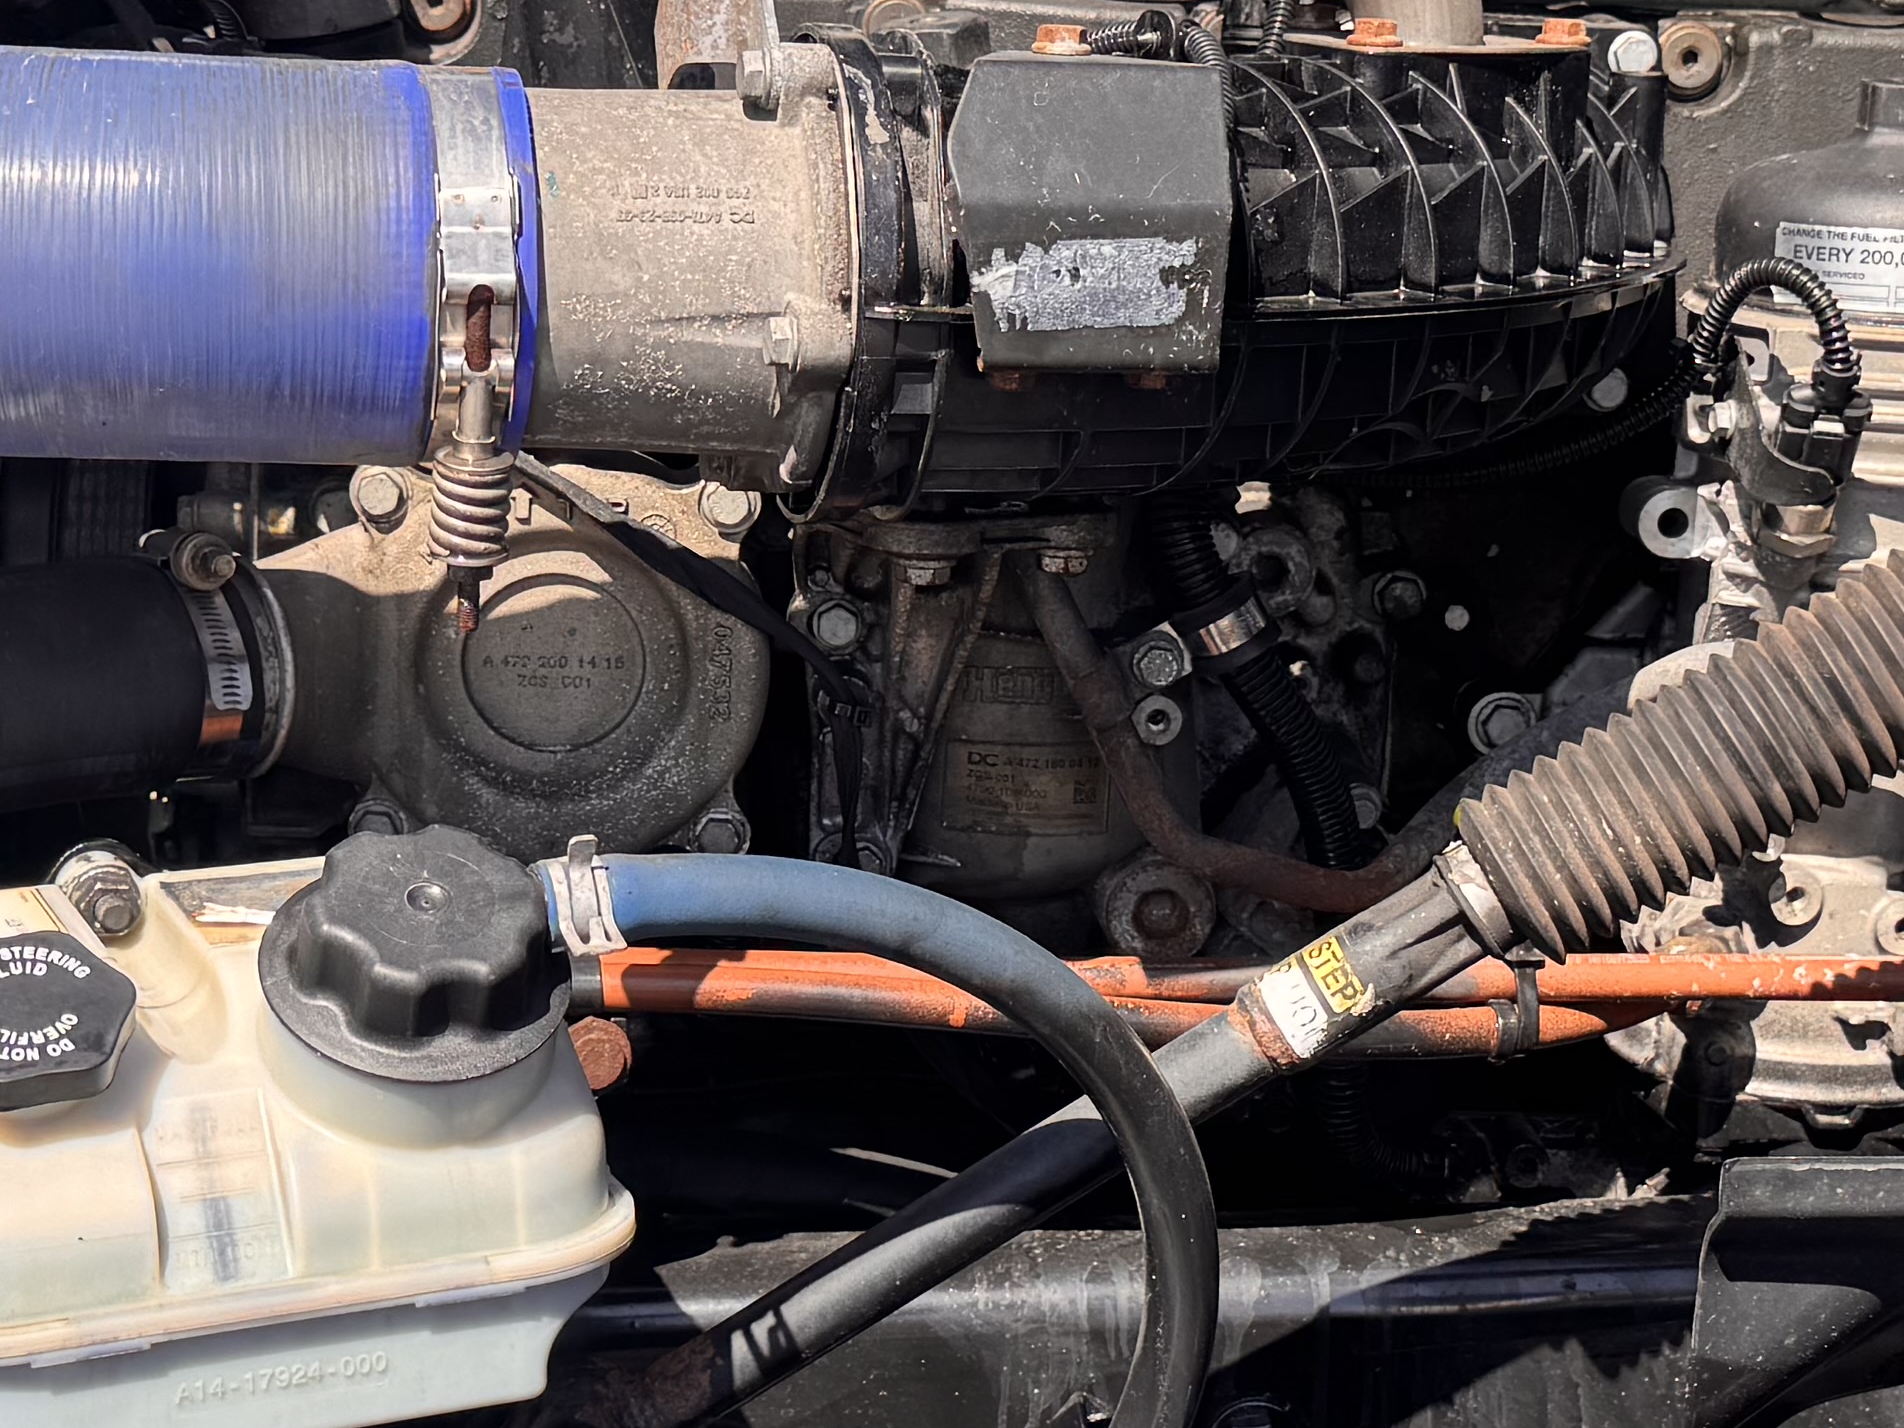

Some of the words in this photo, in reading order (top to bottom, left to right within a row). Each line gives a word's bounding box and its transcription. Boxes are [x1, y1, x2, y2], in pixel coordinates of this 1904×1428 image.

[1781, 227, 1823, 240] CHANGE
[1826, 230, 1847, 241] THE
[1850, 232, 1880, 243] FUEL
[1793, 244, 1855, 263] EVERY
[1822, 269, 1865, 281] SERVICED
[482, 656, 494, 668] A
[967, 751, 999, 767] DC
[1309, 941, 1359, 1000] STEP
[46, 1038, 76, 1057] DO
[175, 1351, 388, 1405] A14-17924-000
